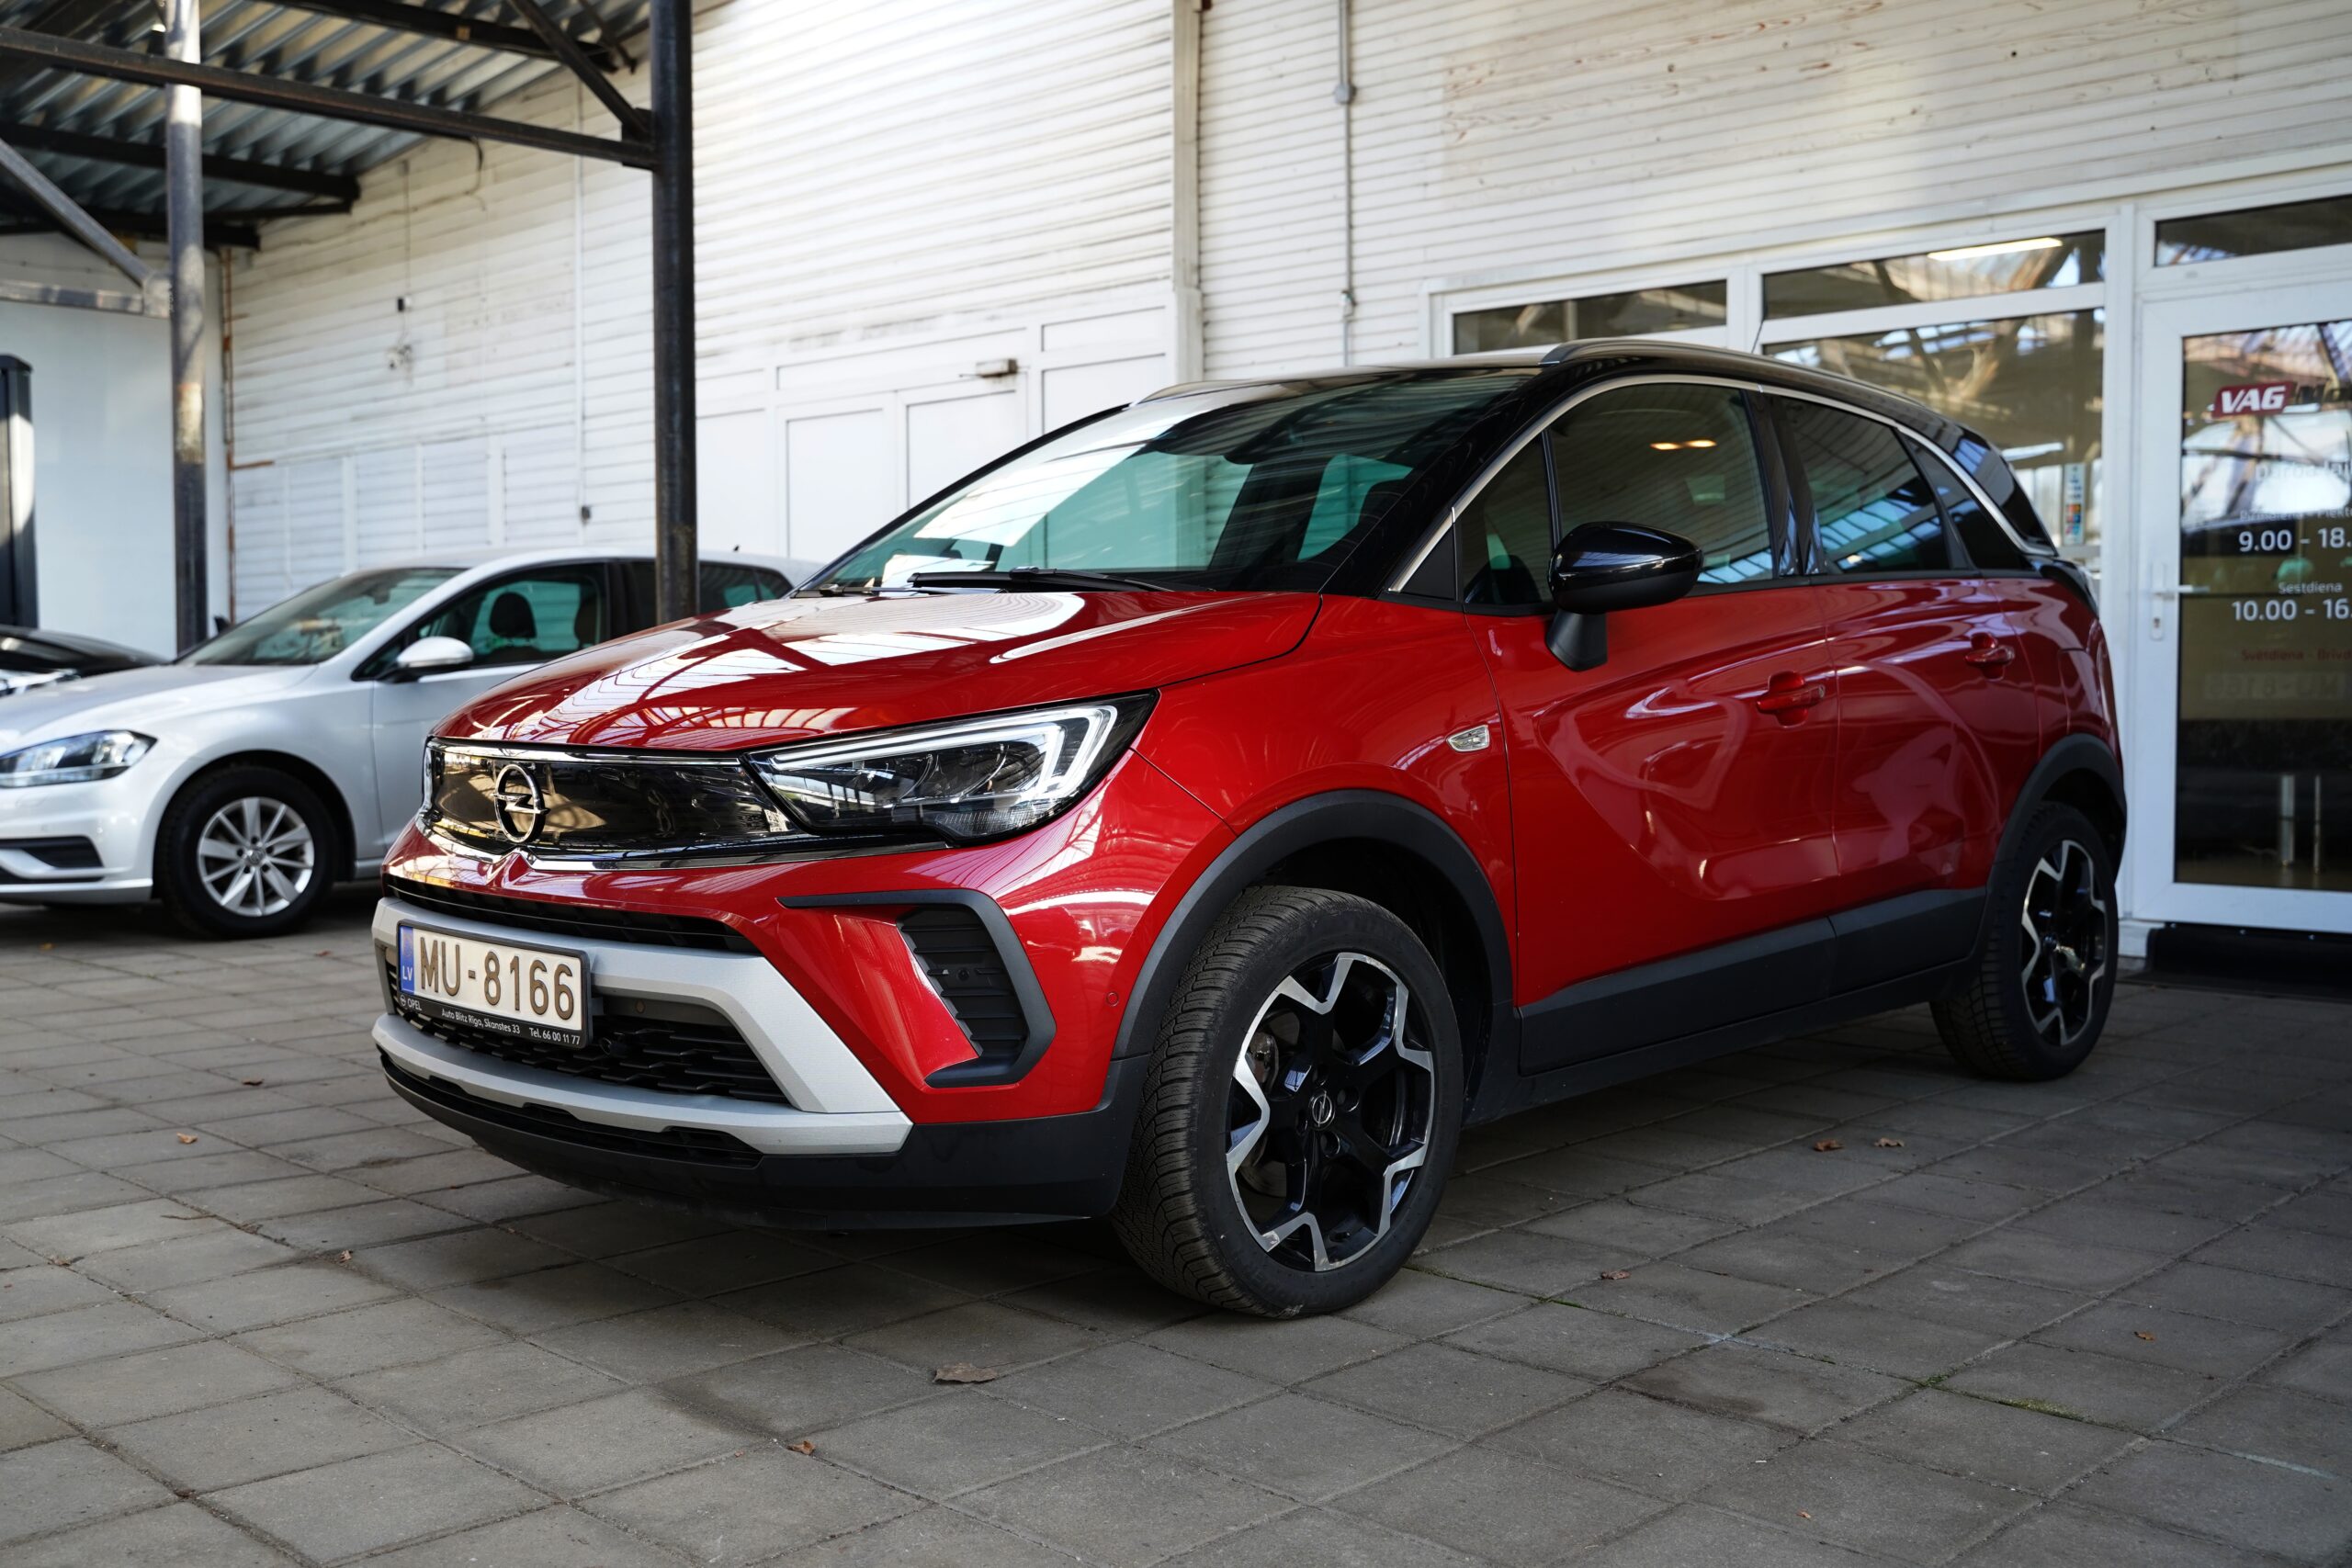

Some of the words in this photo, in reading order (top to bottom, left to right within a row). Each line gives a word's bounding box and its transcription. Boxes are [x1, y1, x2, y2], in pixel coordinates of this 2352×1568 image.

[2221, 386, 2287, 413] VAG
[2239, 529, 2292, 552] 9.00
[2278, 581, 2343, 595] Sestdiena
[2231, 599, 2297, 621] 10.00
[402, 965, 413, 981] LV
[420, 937, 574, 1021] MU-8166
[407, 998, 422, 1011] OPEL
[441, 1009, 455, 1020] Auto
[455, 1011, 468, 1022] Blitz
[483, 1018, 512, 1032] Skanstes
[512, 1024, 521, 1034] 33
[528, 1027, 542, 1039] Tel.
[542, 1030, 551, 1040] 66
[551, 1032, 561, 1042] 00
[562, 1033, 570, 1043] 11
[571, 1034, 581, 1045] 77
